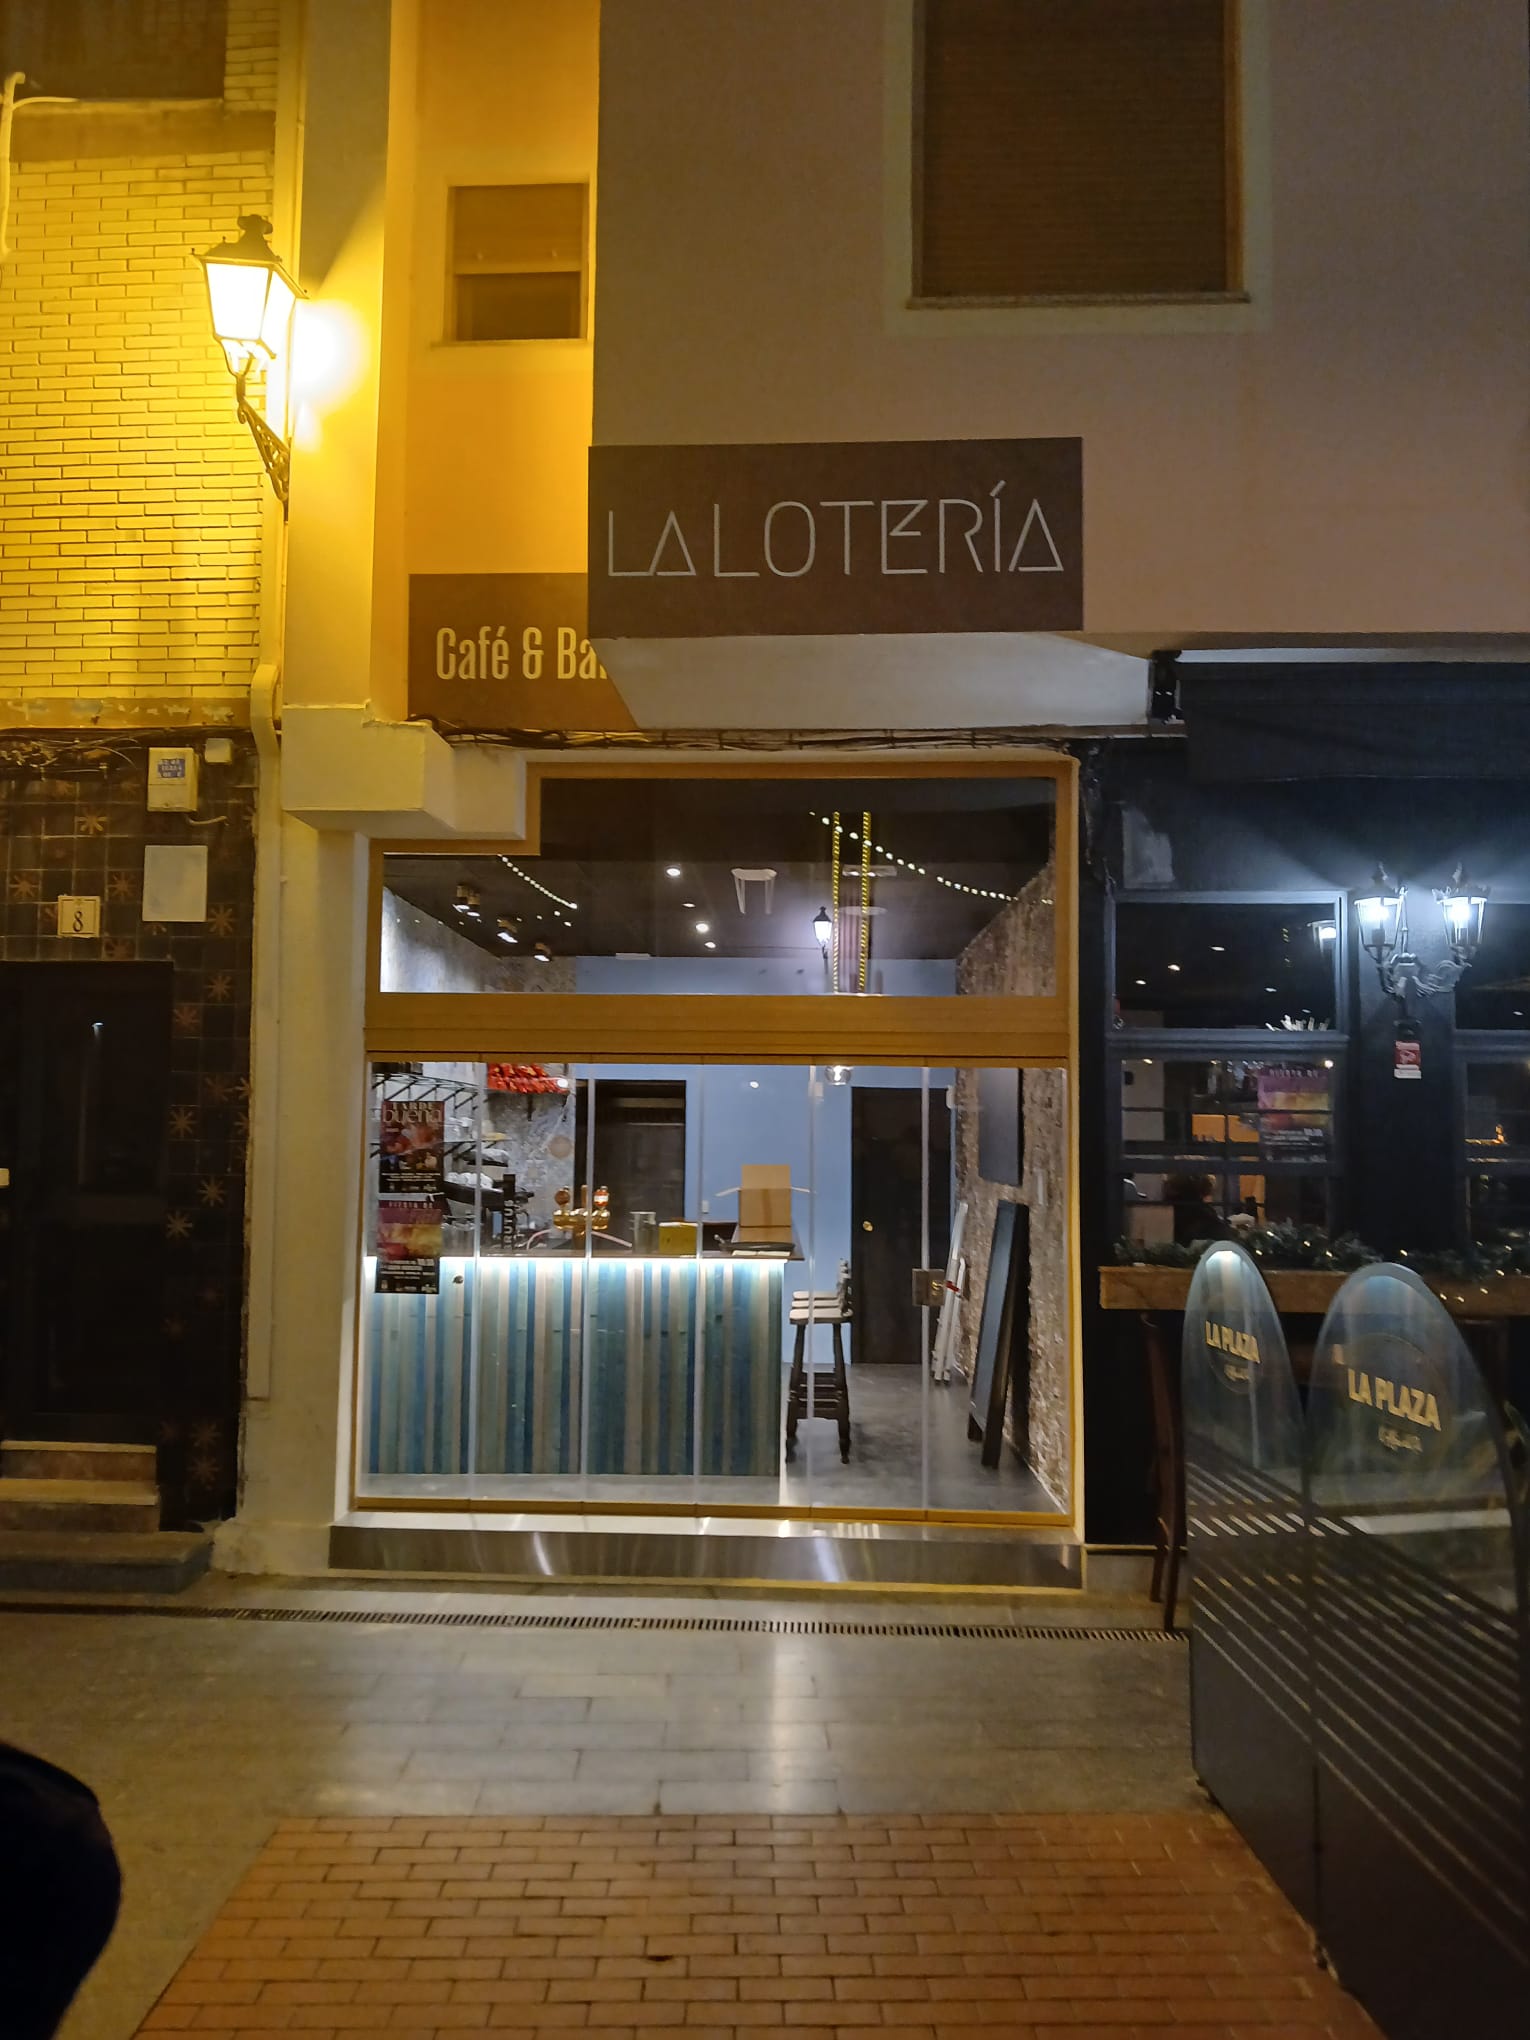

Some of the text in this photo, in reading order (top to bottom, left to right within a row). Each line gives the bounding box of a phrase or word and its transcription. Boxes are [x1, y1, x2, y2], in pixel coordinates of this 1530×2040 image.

[608, 480, 1065, 578] LA LOTERÍA
[436, 625, 608, 680] Café & Ba
[72, 910, 84, 932] 8
[382, 1104, 443, 1123] buena
[1205, 1320, 1261, 1364] LA PLAZA
[1347, 1368, 1442, 1432] LA PLAZA
